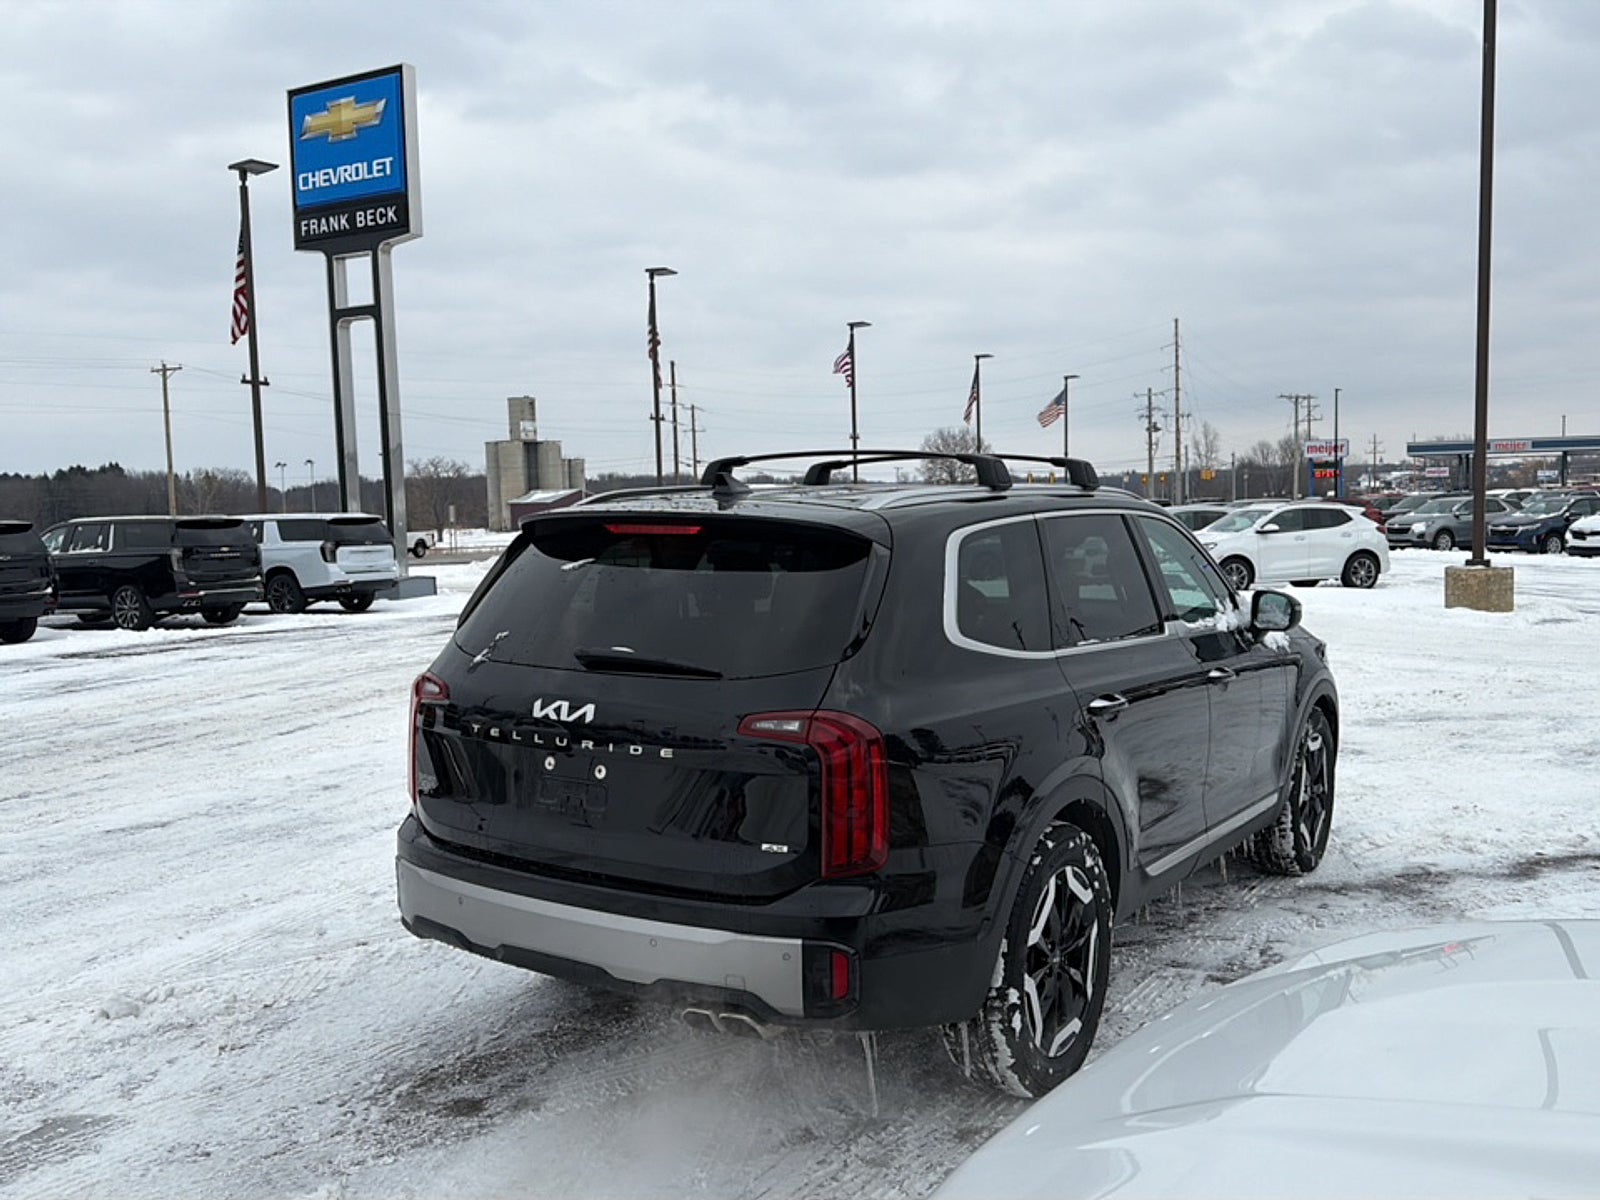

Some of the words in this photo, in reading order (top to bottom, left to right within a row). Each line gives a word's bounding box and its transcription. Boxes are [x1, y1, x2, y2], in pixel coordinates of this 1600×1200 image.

[299, 157, 393, 191] CHEVROLET
[301, 213, 350, 237] FRANK
[356, 205, 398, 228] BECK
[532, 698, 596, 724] KIA
[471, 723, 674, 758] TELLURIDE
